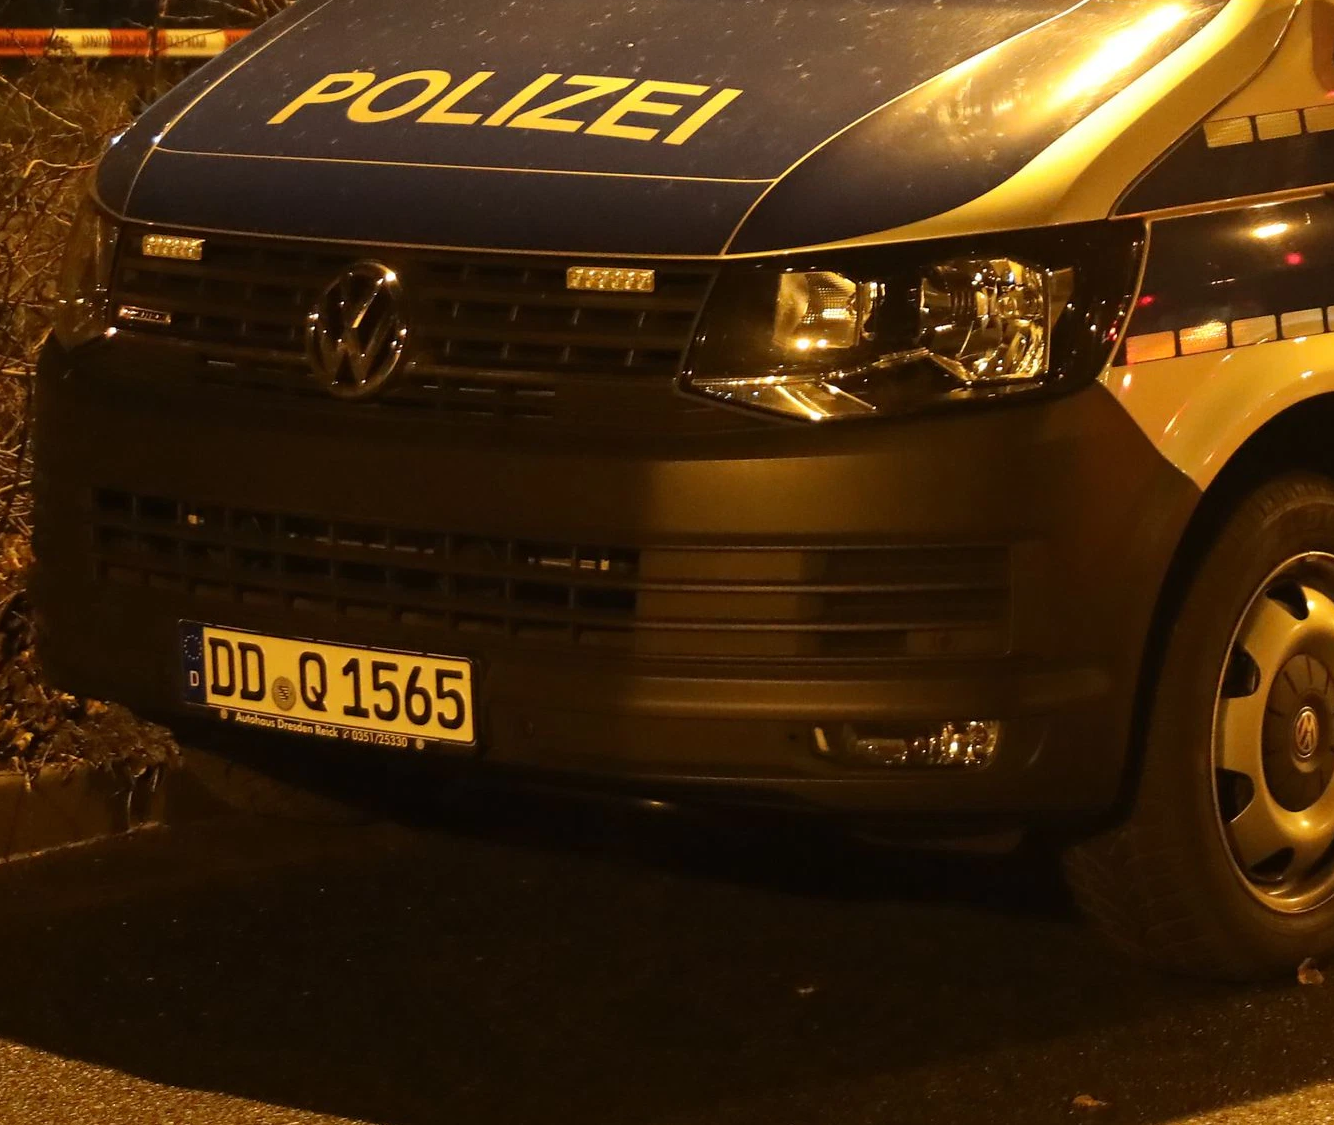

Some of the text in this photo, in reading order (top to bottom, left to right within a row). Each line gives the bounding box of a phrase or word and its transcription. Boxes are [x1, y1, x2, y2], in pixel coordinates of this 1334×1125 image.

[267, 69, 744, 146] POLIZEI
[189, 670, 199, 687] D
[208, 636, 466, 730] DD Q 1565
[235, 712, 276, 728] Autohaus
[277, 718, 313, 734] Dresden
